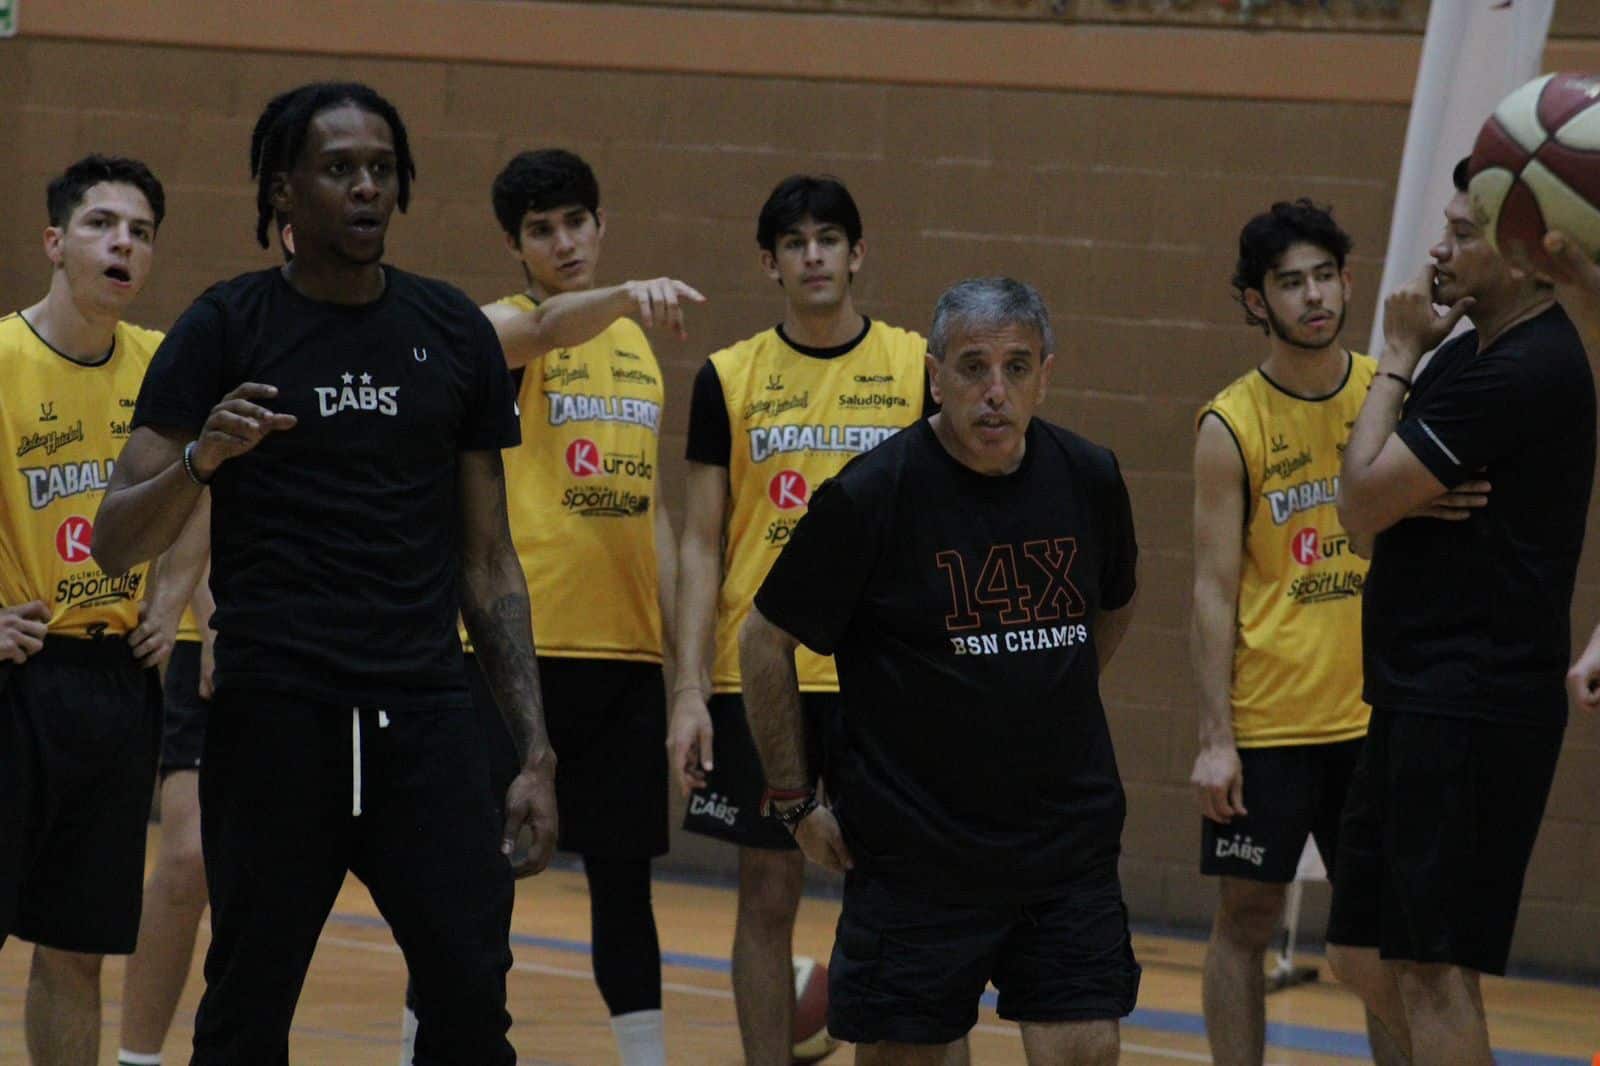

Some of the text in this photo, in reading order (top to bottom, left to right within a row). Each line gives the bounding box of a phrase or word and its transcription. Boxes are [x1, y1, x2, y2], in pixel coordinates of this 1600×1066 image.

[313, 386, 401, 417] CABS
[748, 425, 904, 464] CABALLERO
[765, 522, 793, 544] Sp
[935, 537, 1086, 631] 14X
[950, 623, 1088, 656] BSN CHAMPS
